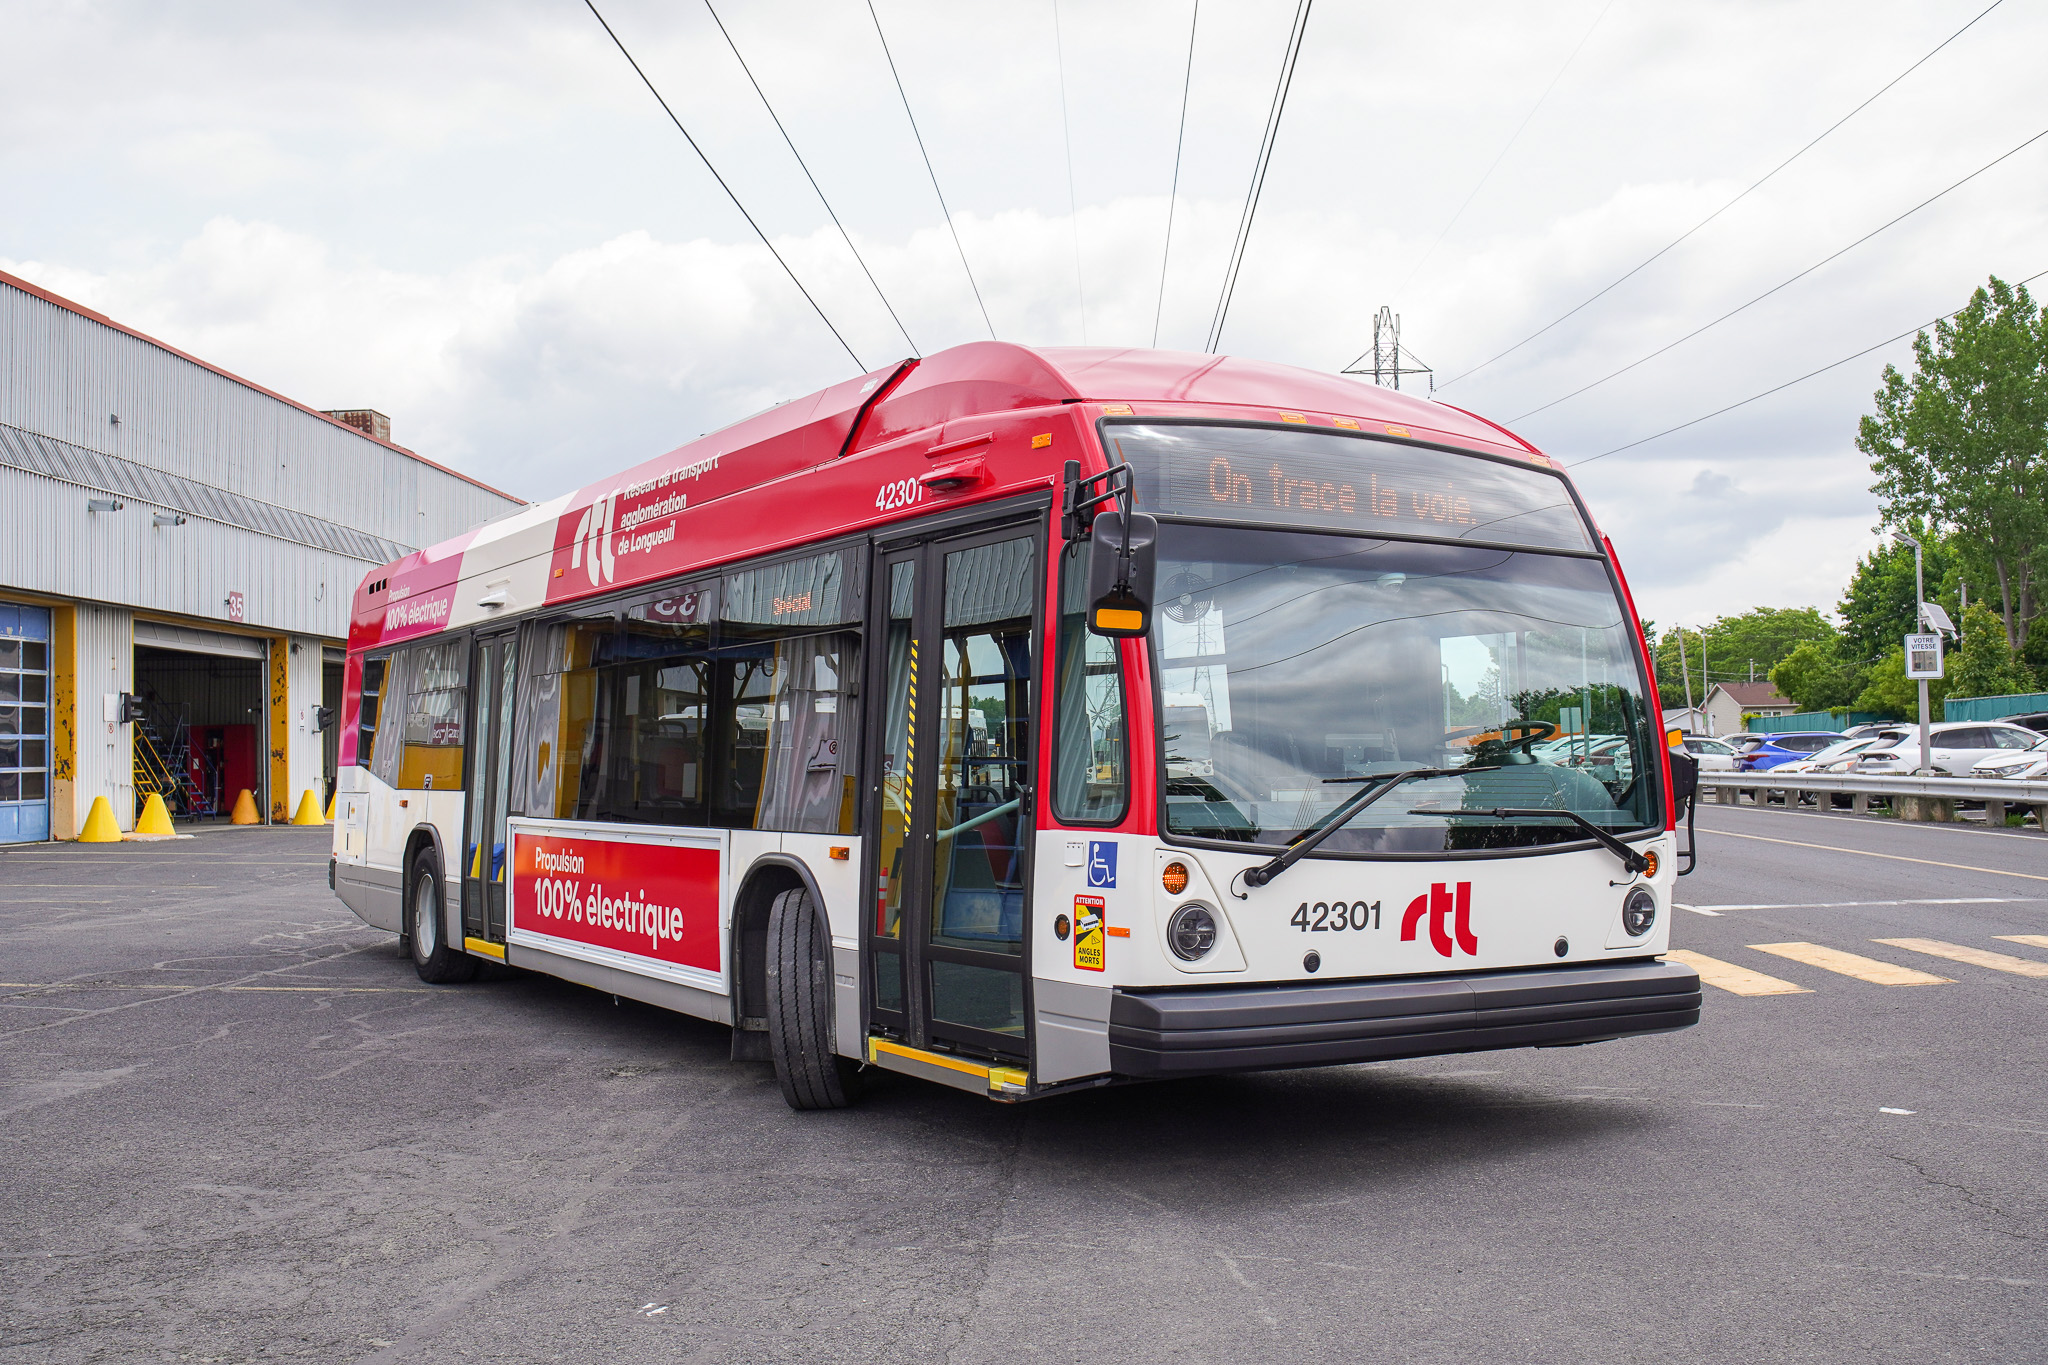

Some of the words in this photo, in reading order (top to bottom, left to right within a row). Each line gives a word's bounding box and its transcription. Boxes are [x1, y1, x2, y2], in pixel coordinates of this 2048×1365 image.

[623, 479, 658, 500] Réseau
[658, 469, 670, 488] de
[672, 451, 721, 484] transport
[1210, 457, 1252, 504] On
[1269, 463, 1357, 513] trace
[1371, 473, 1398, 517] la
[1412, 482, 1477, 525] voie.
[620, 491, 687, 532] agglomération
[875, 477, 923, 511] 42301
[571, 488, 621, 587] rtl
[618, 536, 629, 556] de
[630, 520, 676, 554] Longueuil
[230, 596, 243, 617] 35
[386, 604, 407, 631] 100%
[409, 595, 447, 625] électrique
[773, 592, 812, 616] Spécial
[535, 847, 584, 878] Propulsion
[534, 877, 583, 923] 100%
[586, 883, 684, 951] électrique
[1076, 897, 1103, 905] ATTENTION
[1290, 900, 1381, 933] 42301
[1400, 881, 1478, 958] rtl
[1078, 947, 1100, 956] ANGLES
[1079, 955, 1099, 964] MORTS
